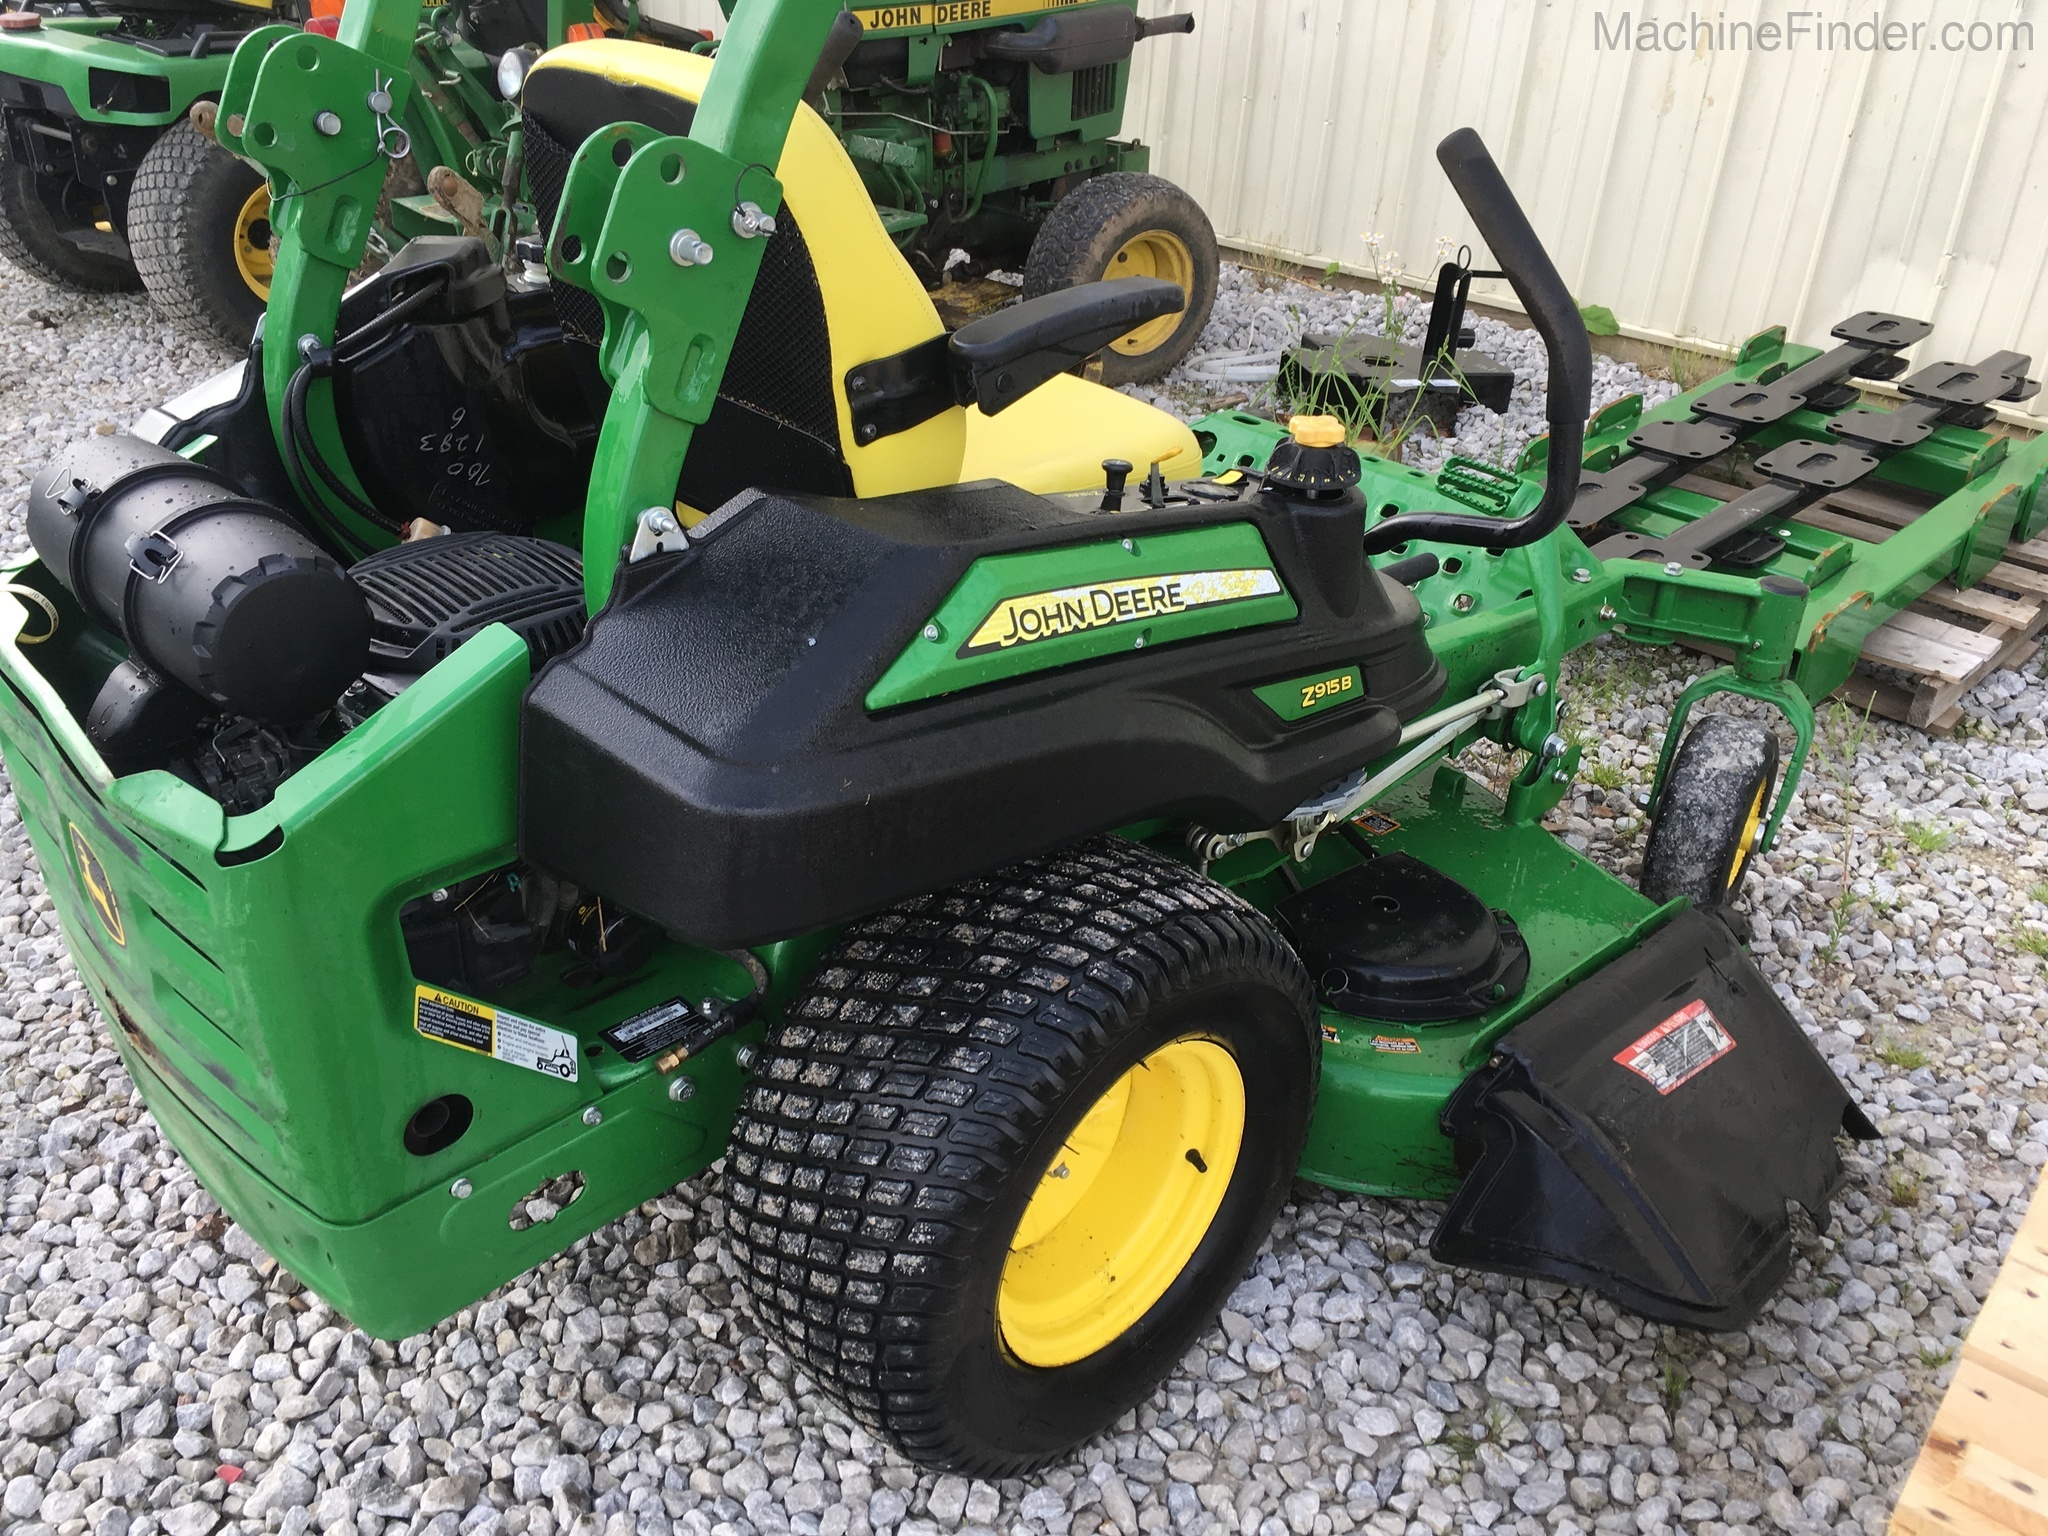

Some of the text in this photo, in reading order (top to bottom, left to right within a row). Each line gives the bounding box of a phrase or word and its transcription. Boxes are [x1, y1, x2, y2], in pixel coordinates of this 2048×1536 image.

[870, 1, 991, 28] JOHN DEERE
[1003, 583, 1185, 641] JOHN DEERE
[443, 996, 480, 1015] CAUTION
